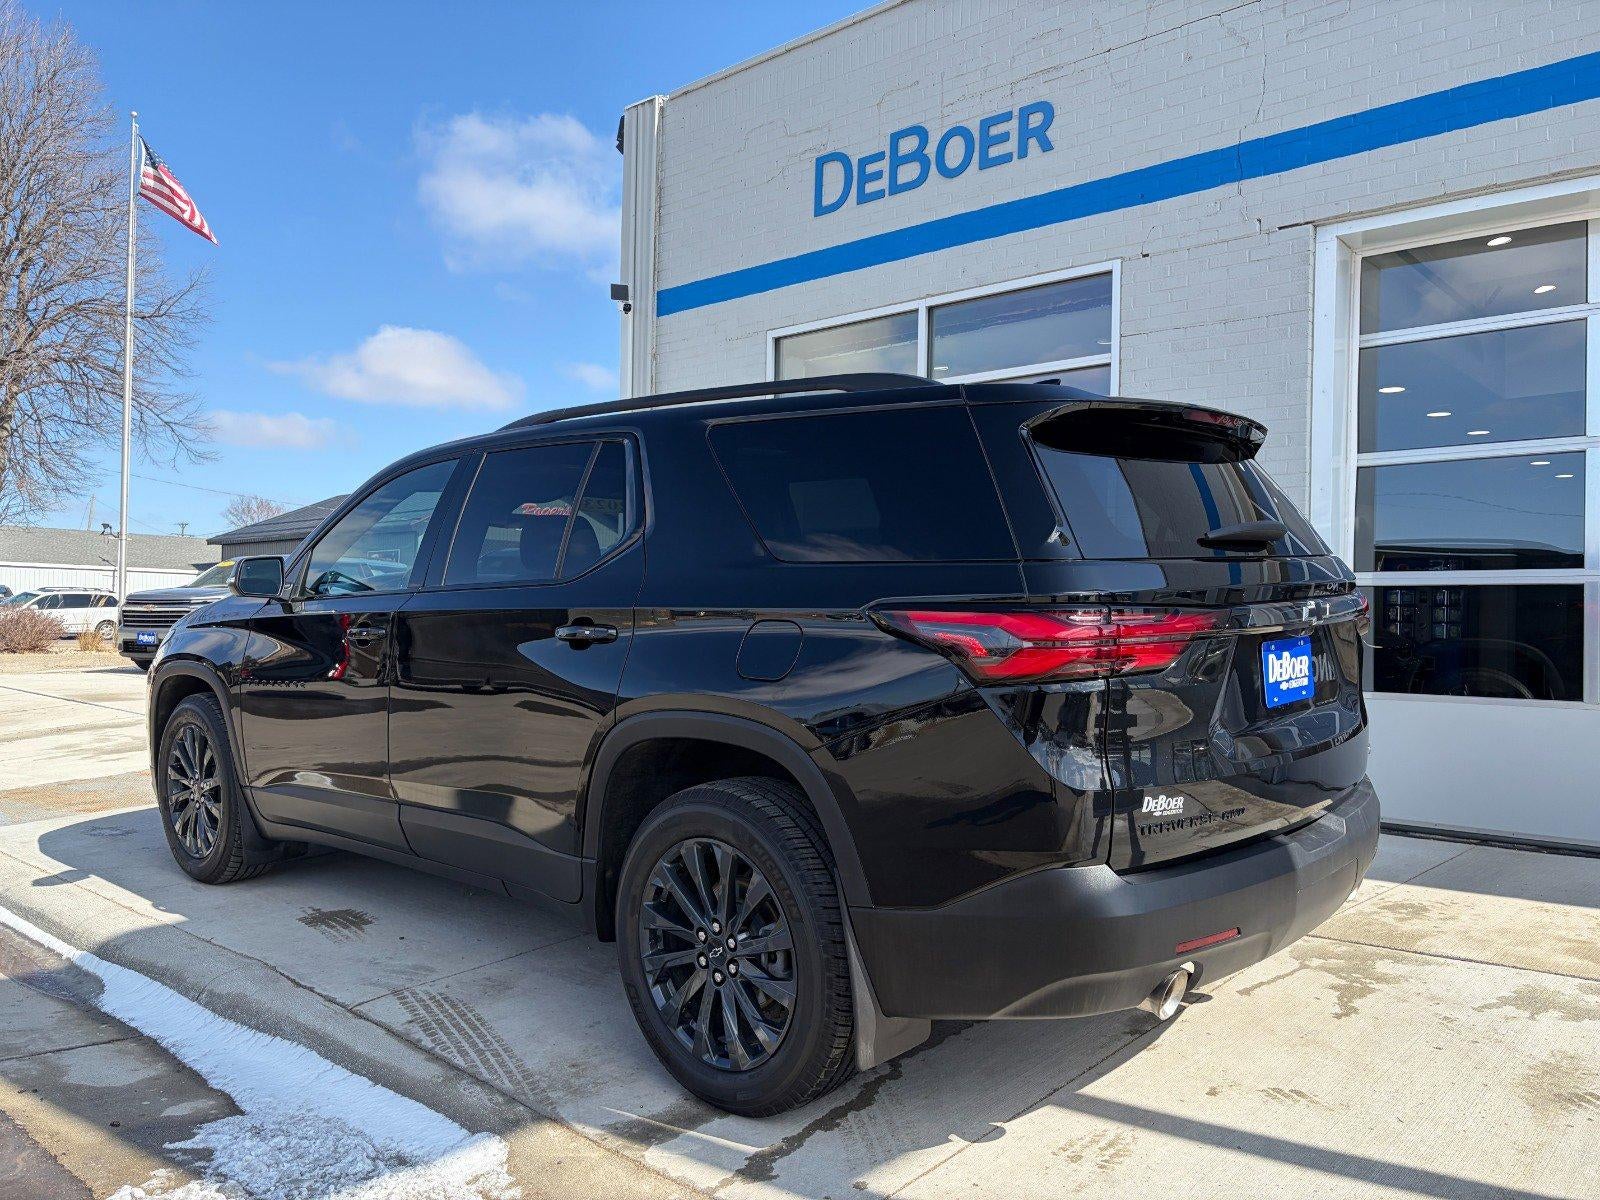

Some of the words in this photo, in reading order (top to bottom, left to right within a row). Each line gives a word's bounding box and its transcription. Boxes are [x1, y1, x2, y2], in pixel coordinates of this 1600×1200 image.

[814, 100, 1055, 217] DEBOER
[1268, 651, 1309, 683] DEBOER
[1142, 794, 1184, 812] DEBOER
